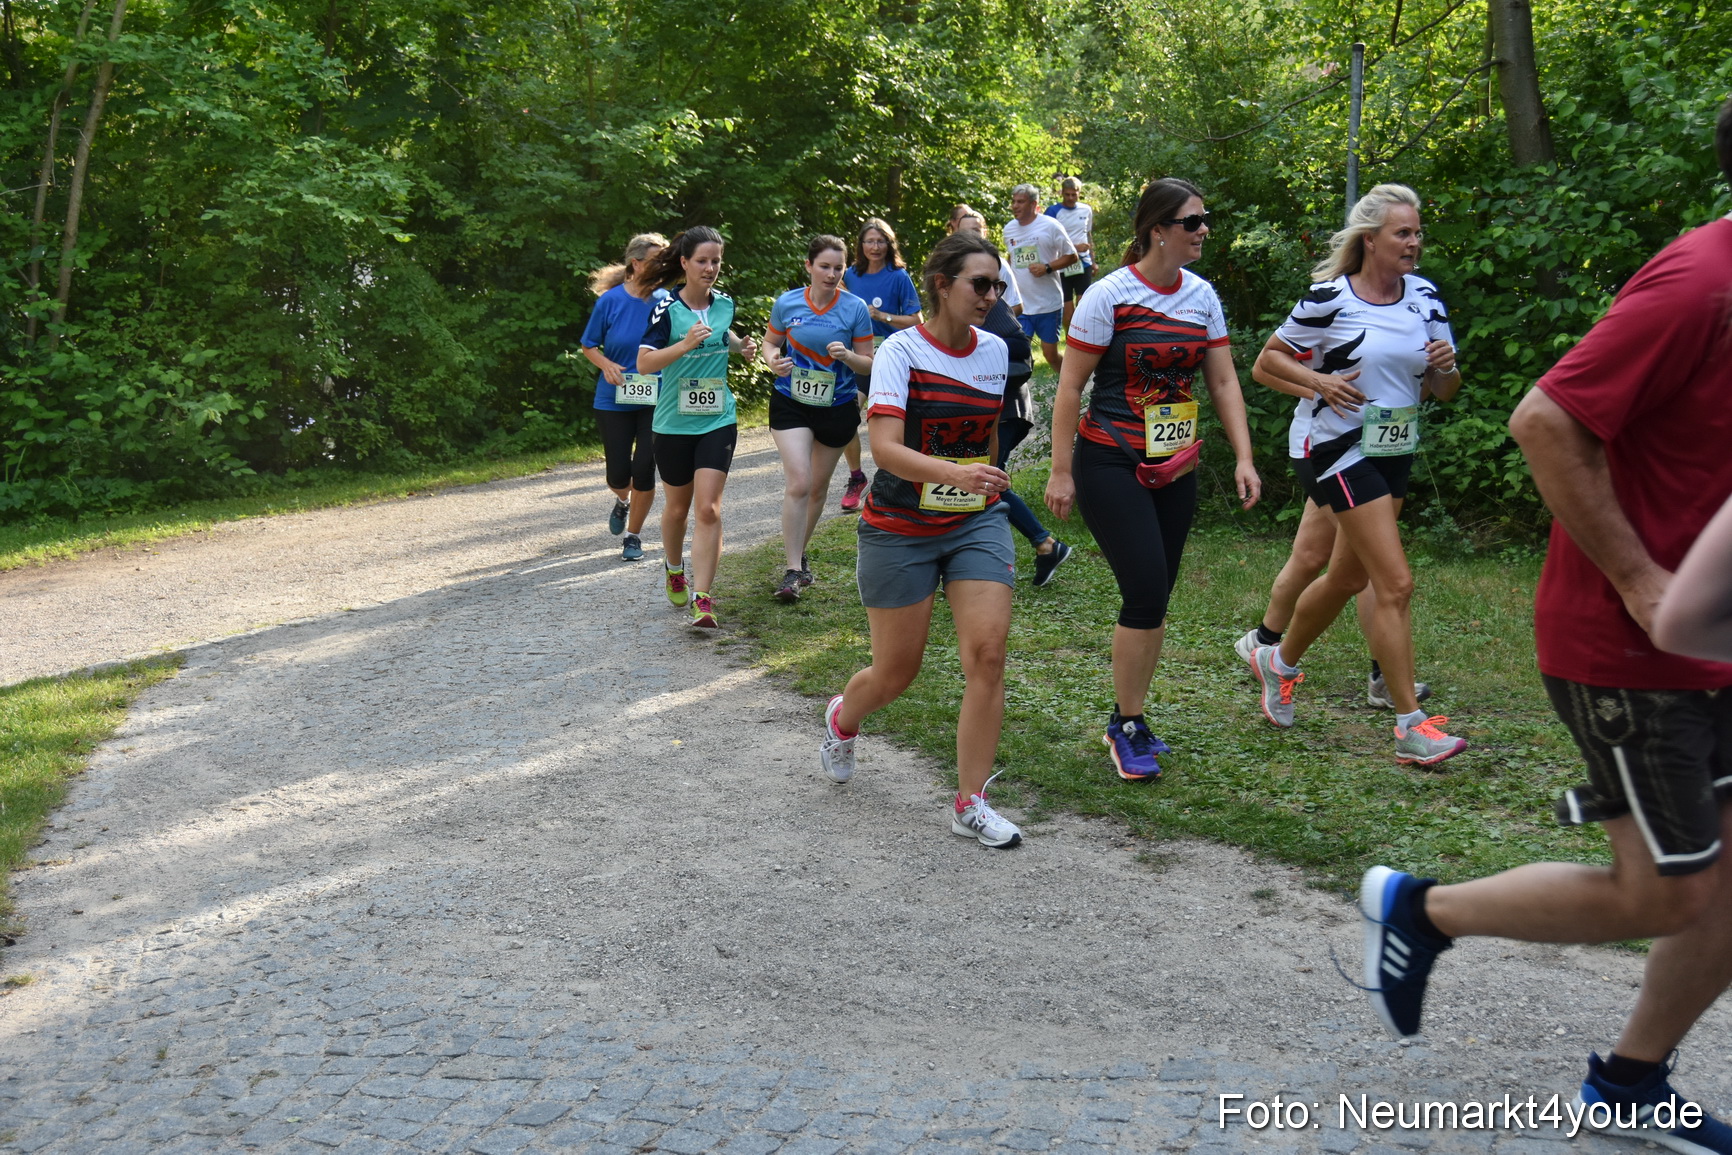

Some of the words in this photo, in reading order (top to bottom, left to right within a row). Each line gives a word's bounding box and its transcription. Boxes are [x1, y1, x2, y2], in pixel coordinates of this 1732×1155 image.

[1016, 252, 1036, 263] 2149
[972, 373, 1003, 382] NEUMARKT
[621, 384, 653, 397] 1398
[795, 380, 829, 397] 1917
[688, 391, 716, 405] 969
[1153, 420, 1192, 442] 2262
[1378, 423, 1409, 443] 794
